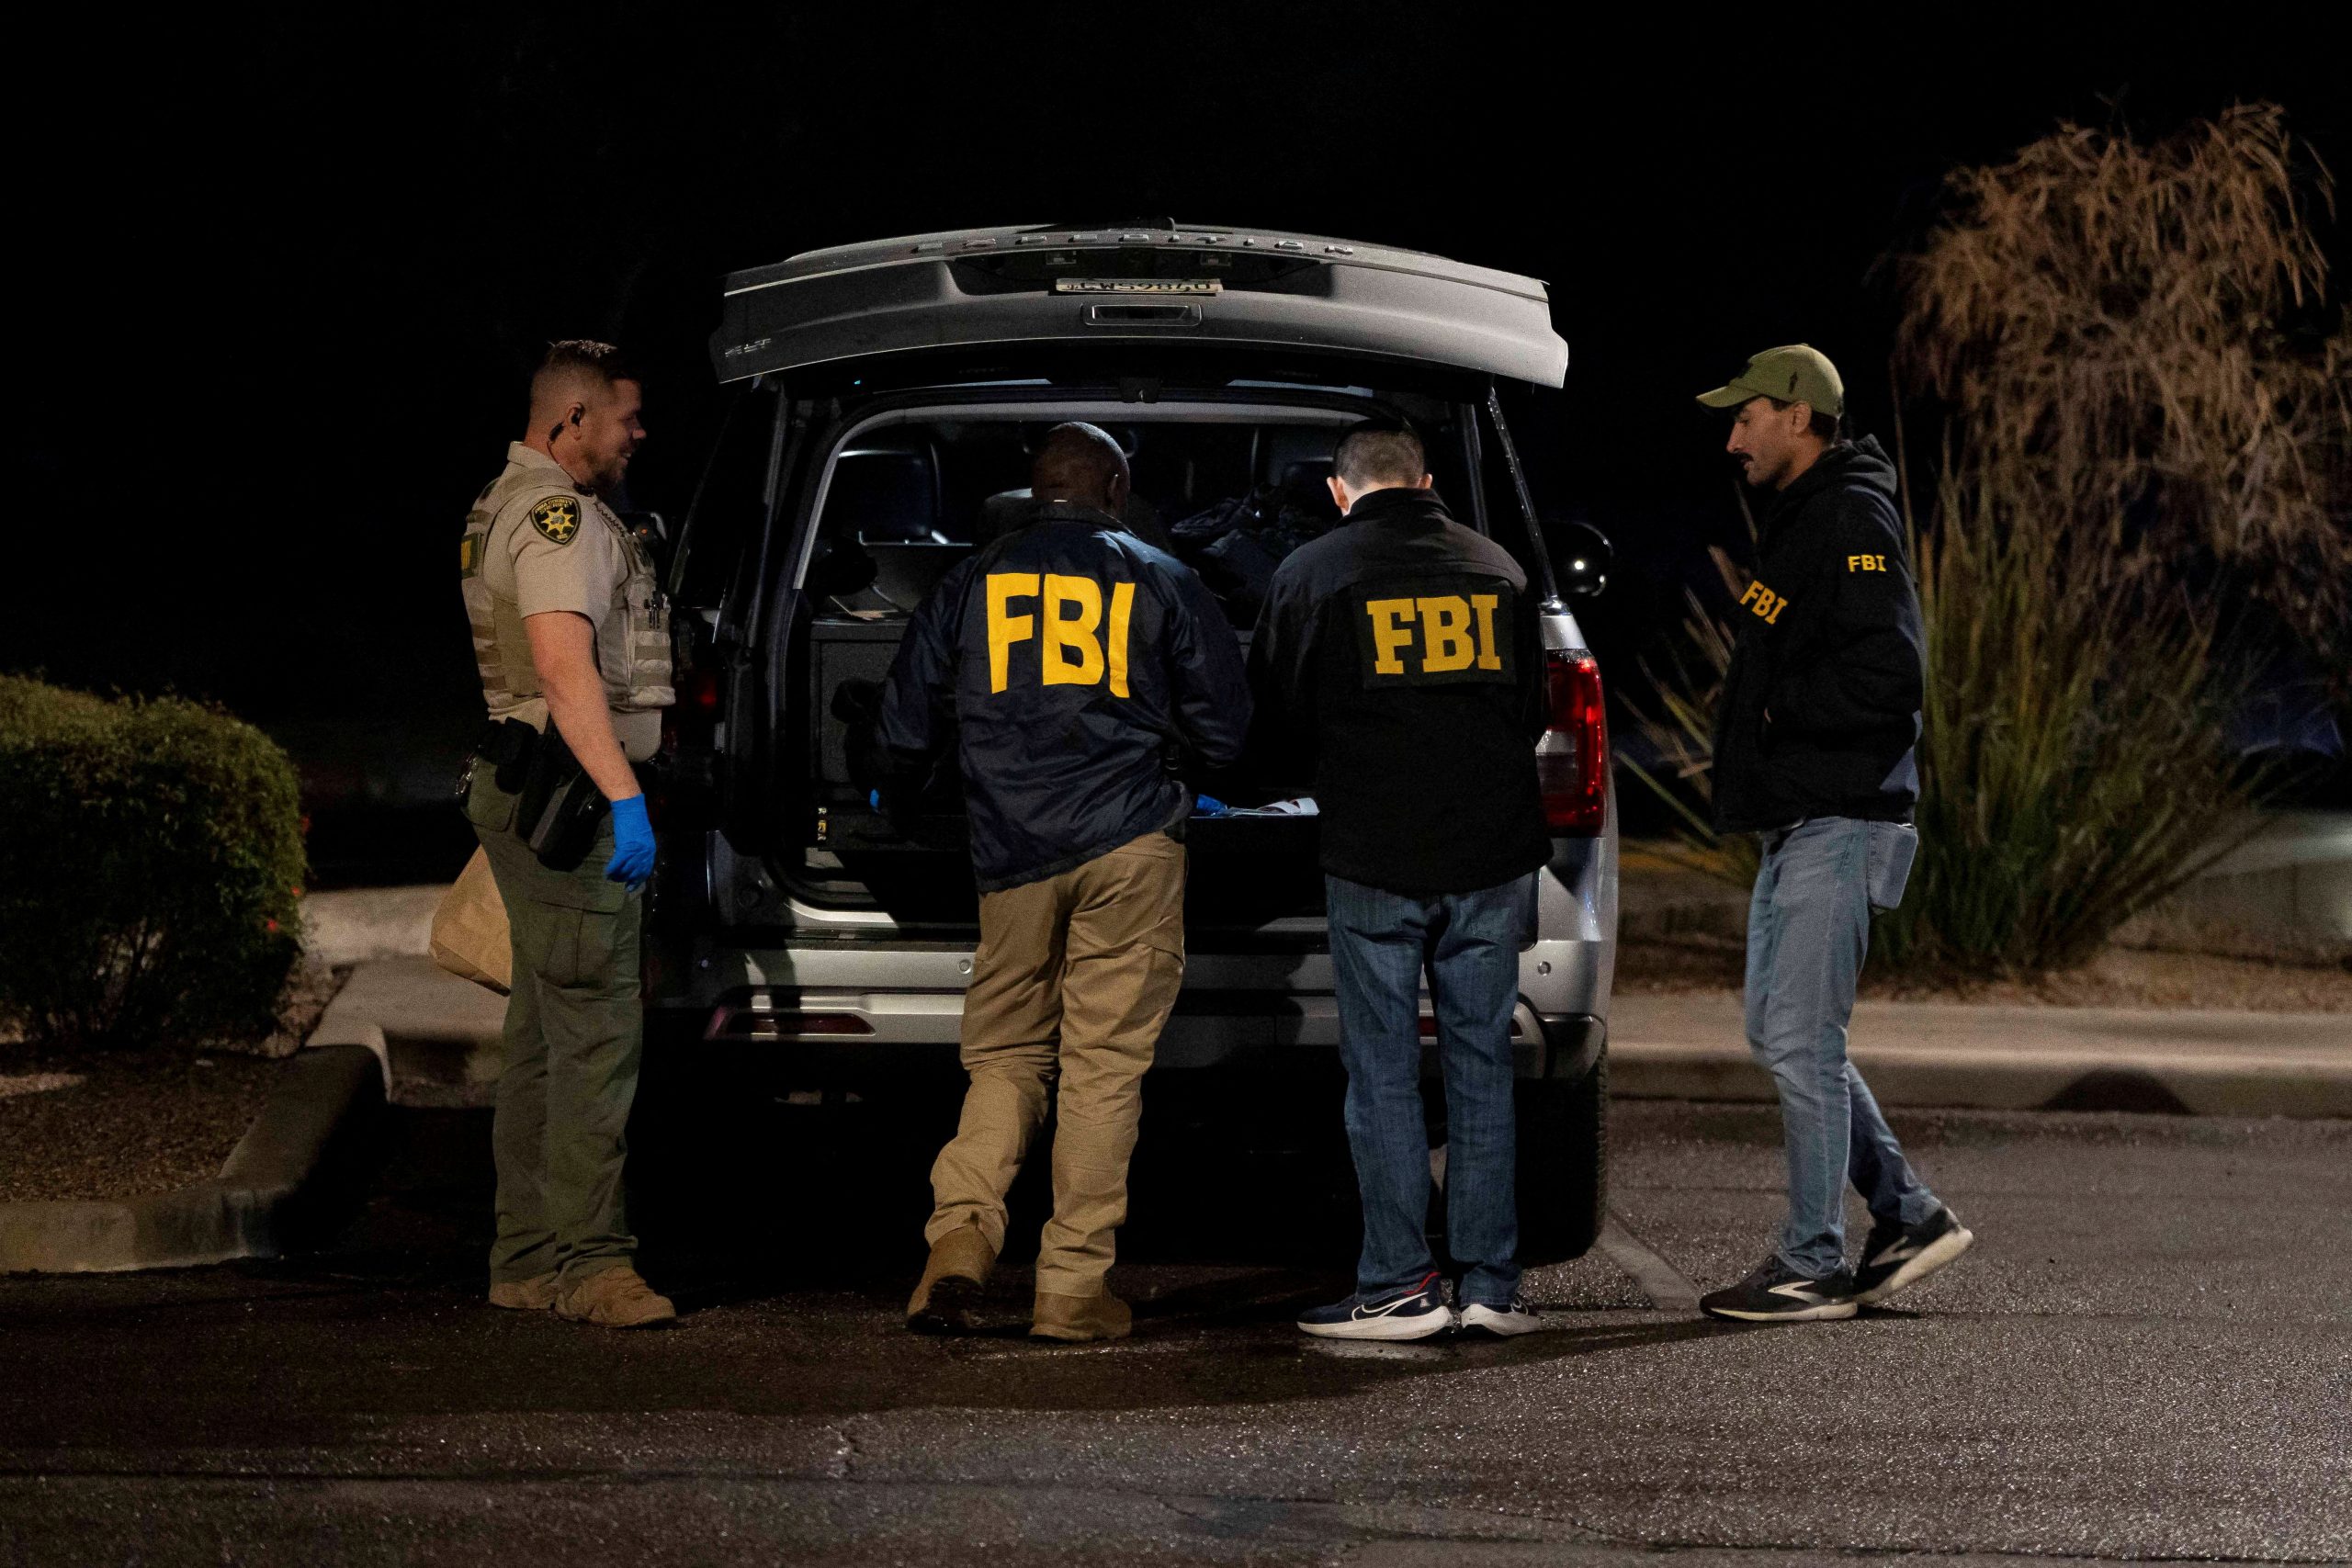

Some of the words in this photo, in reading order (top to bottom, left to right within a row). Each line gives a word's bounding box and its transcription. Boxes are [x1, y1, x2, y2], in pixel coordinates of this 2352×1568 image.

[1849, 556, 1886, 572] FBI
[1741, 581, 1788, 625] FBI
[988, 574, 1136, 698] FBI
[1368, 596, 1501, 674] FBI
